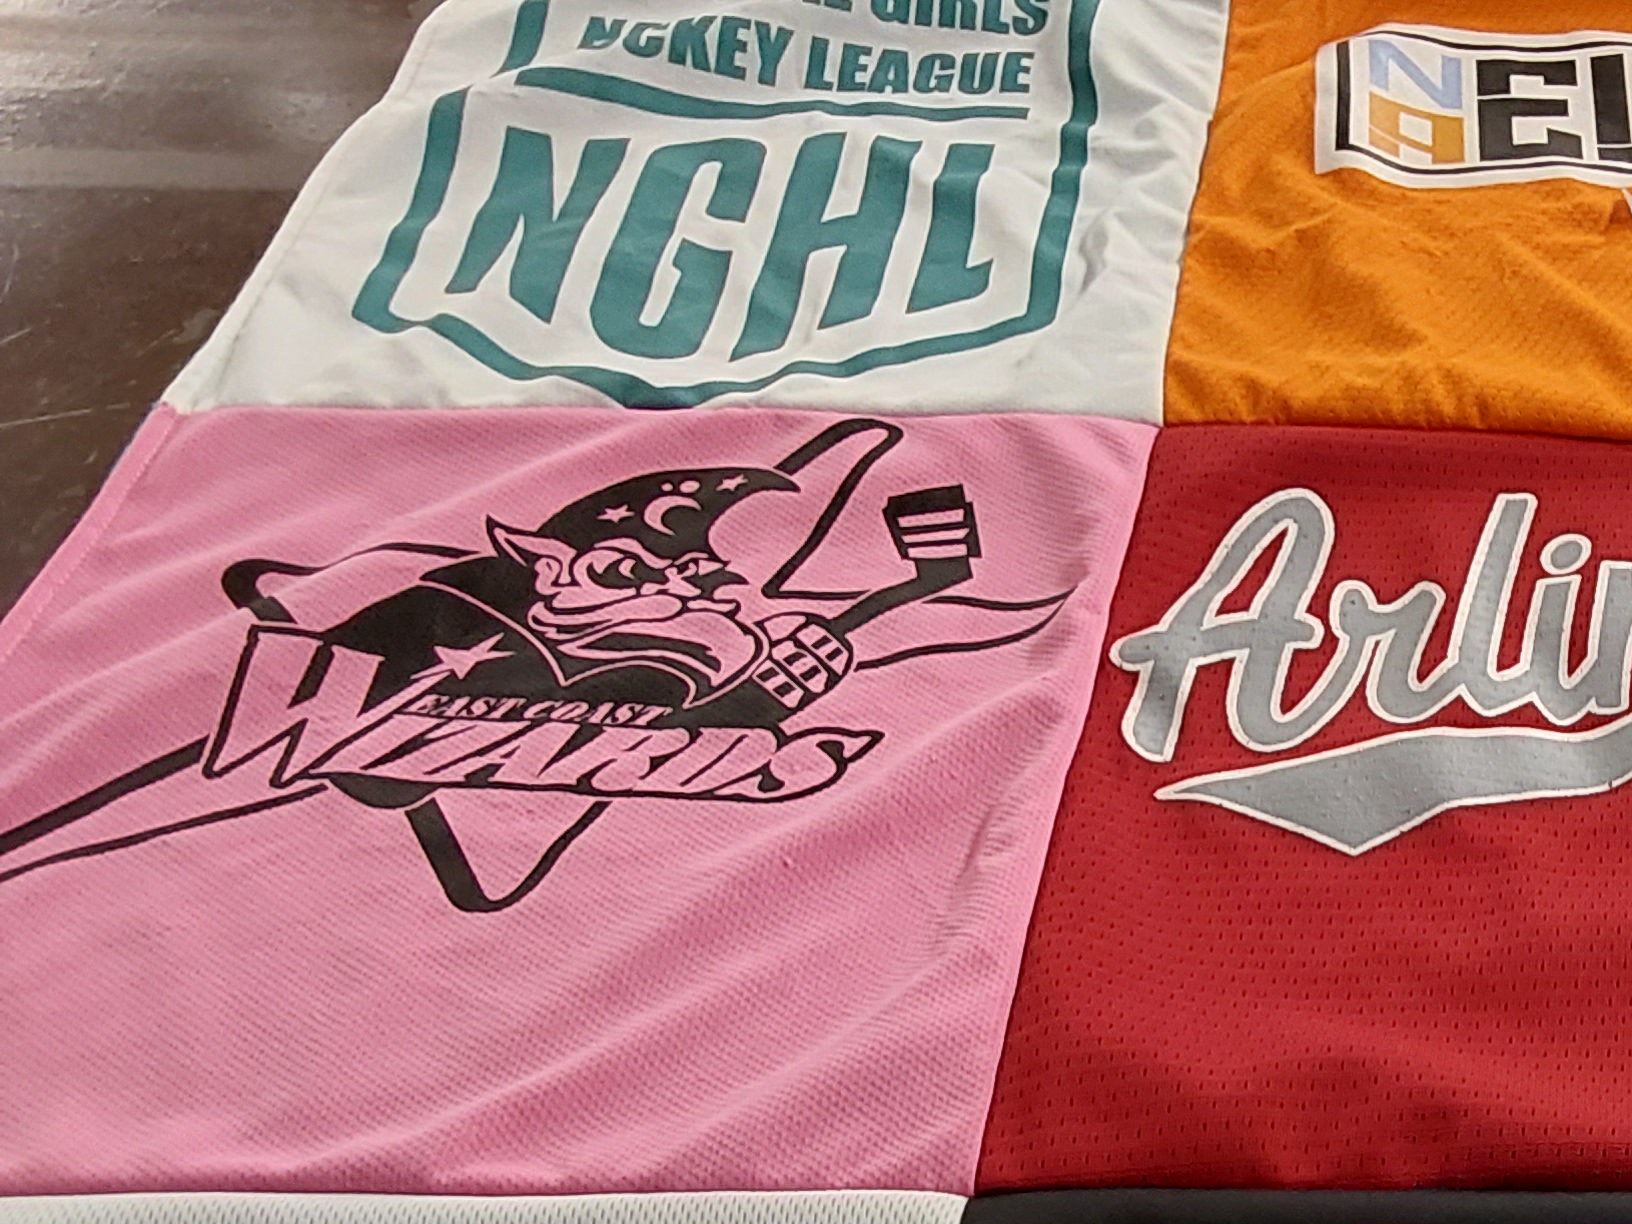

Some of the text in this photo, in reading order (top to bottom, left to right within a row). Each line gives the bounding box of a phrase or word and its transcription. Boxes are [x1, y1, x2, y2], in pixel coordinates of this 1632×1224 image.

[803, 35, 1036, 95] LEAGUE
[444, 126, 995, 362] NGHL
[403, 693, 674, 726] EAST COAST
